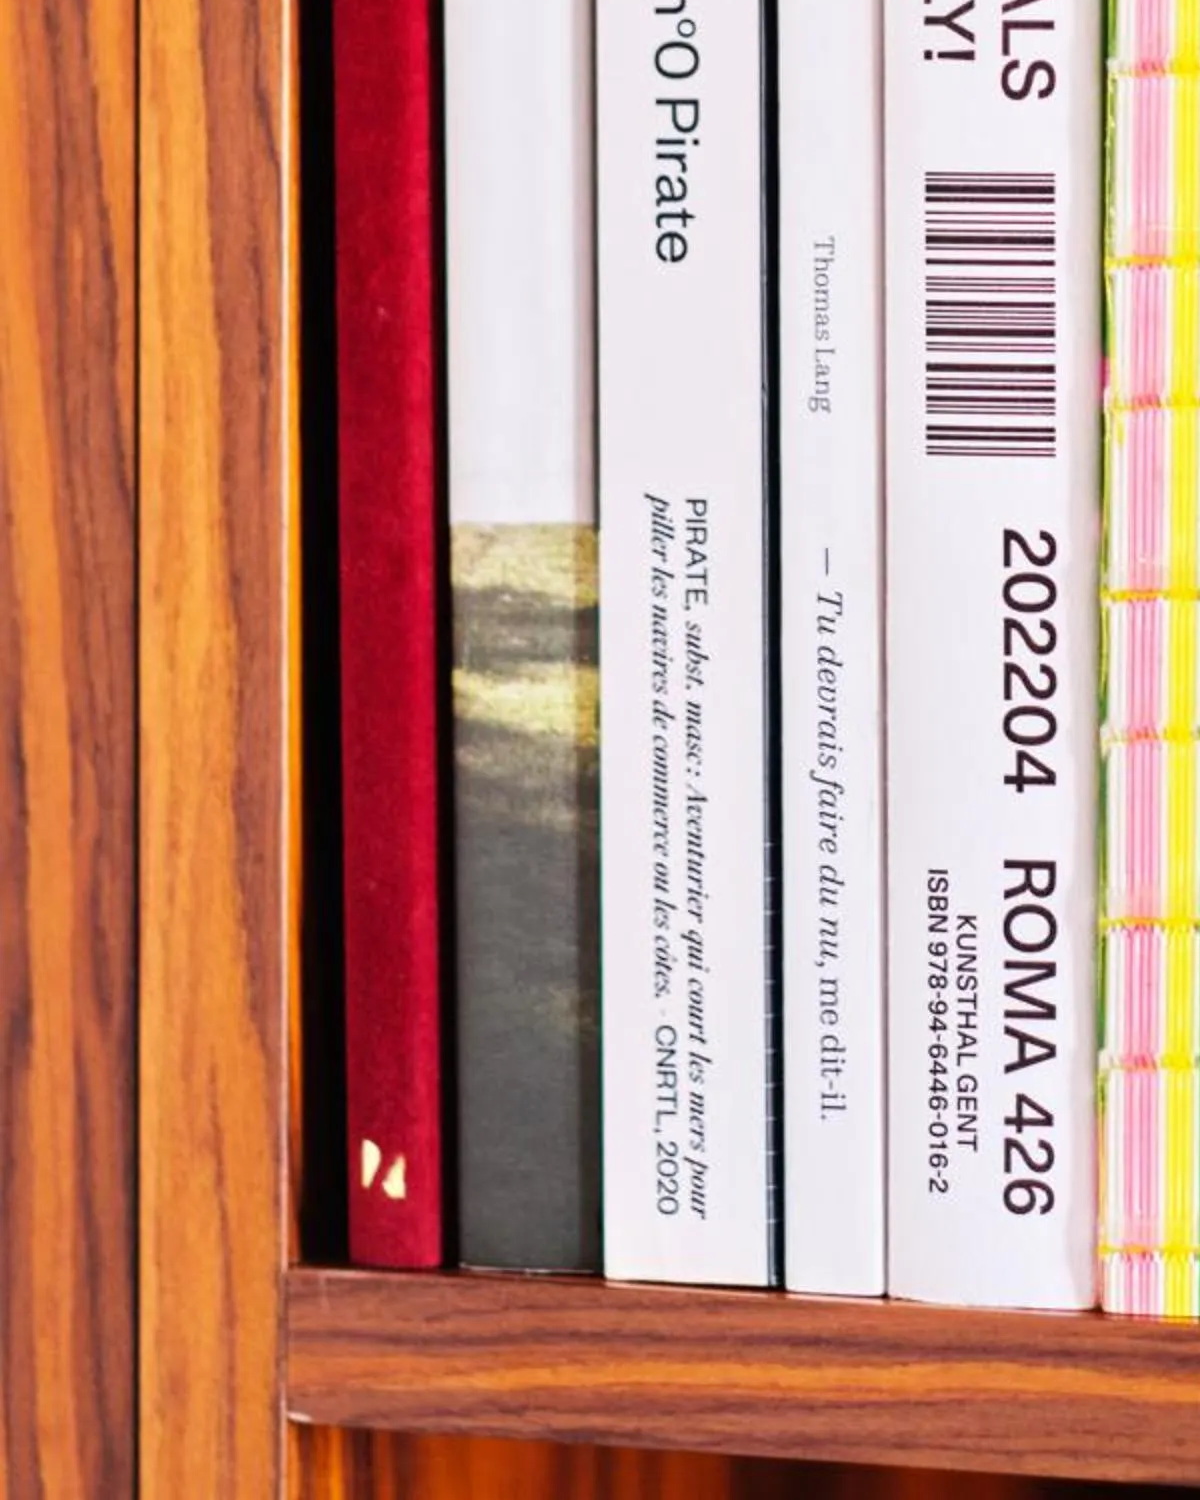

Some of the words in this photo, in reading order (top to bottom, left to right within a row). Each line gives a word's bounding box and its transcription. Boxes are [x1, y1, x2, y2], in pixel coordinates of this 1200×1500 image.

[656, 99, 699, 262] Pirate
[814, 236, 835, 340] Thomas
[808, 348, 835, 414] Lang
[644, 493, 675, 563] piller
[683, 498, 708, 611] PIRATE,
[652, 566, 675, 598] les
[817, 591, 843, 634] Tu
[652, 604, 673, 694] navires
[685, 621, 709, 690] subst.
[1003, 529, 1057, 793] 202204
[652, 699, 675, 730] de
[817, 645, 843, 768] devrais
[653, 734, 669, 857] commerce
[810, 770, 844, 854] faire
[653, 861, 670, 894] ou
[687, 783, 709, 924] Aventurier
[820, 865, 845, 906] du
[654, 898, 678, 930] les
[927, 868, 948, 933] ISBN
[654, 935, 678, 999] côtes.
[681, 929, 710, 974] qui
[816, 917, 840, 968] nu,
[1004, 860, 1057, 1073] ROMA
[687, 977, 709, 1044] court
[820, 977, 840, 1026] me
[957, 914, 977, 1067] KUNSTHAL
[654, 1024, 678, 1134] CNRTL,
[689, 1051, 713, 1084] les
[820, 1034, 847, 1120] dit-il.
[927, 941, 948, 1194] 978-94-6446-016-2
[690, 1092, 707, 1152] mers
[957, 1074, 977, 1152] GENT
[656, 1141, 680, 1216] 2020
[684, 1157, 709, 1220] pour
[1004, 1094, 1054, 1214] 426
